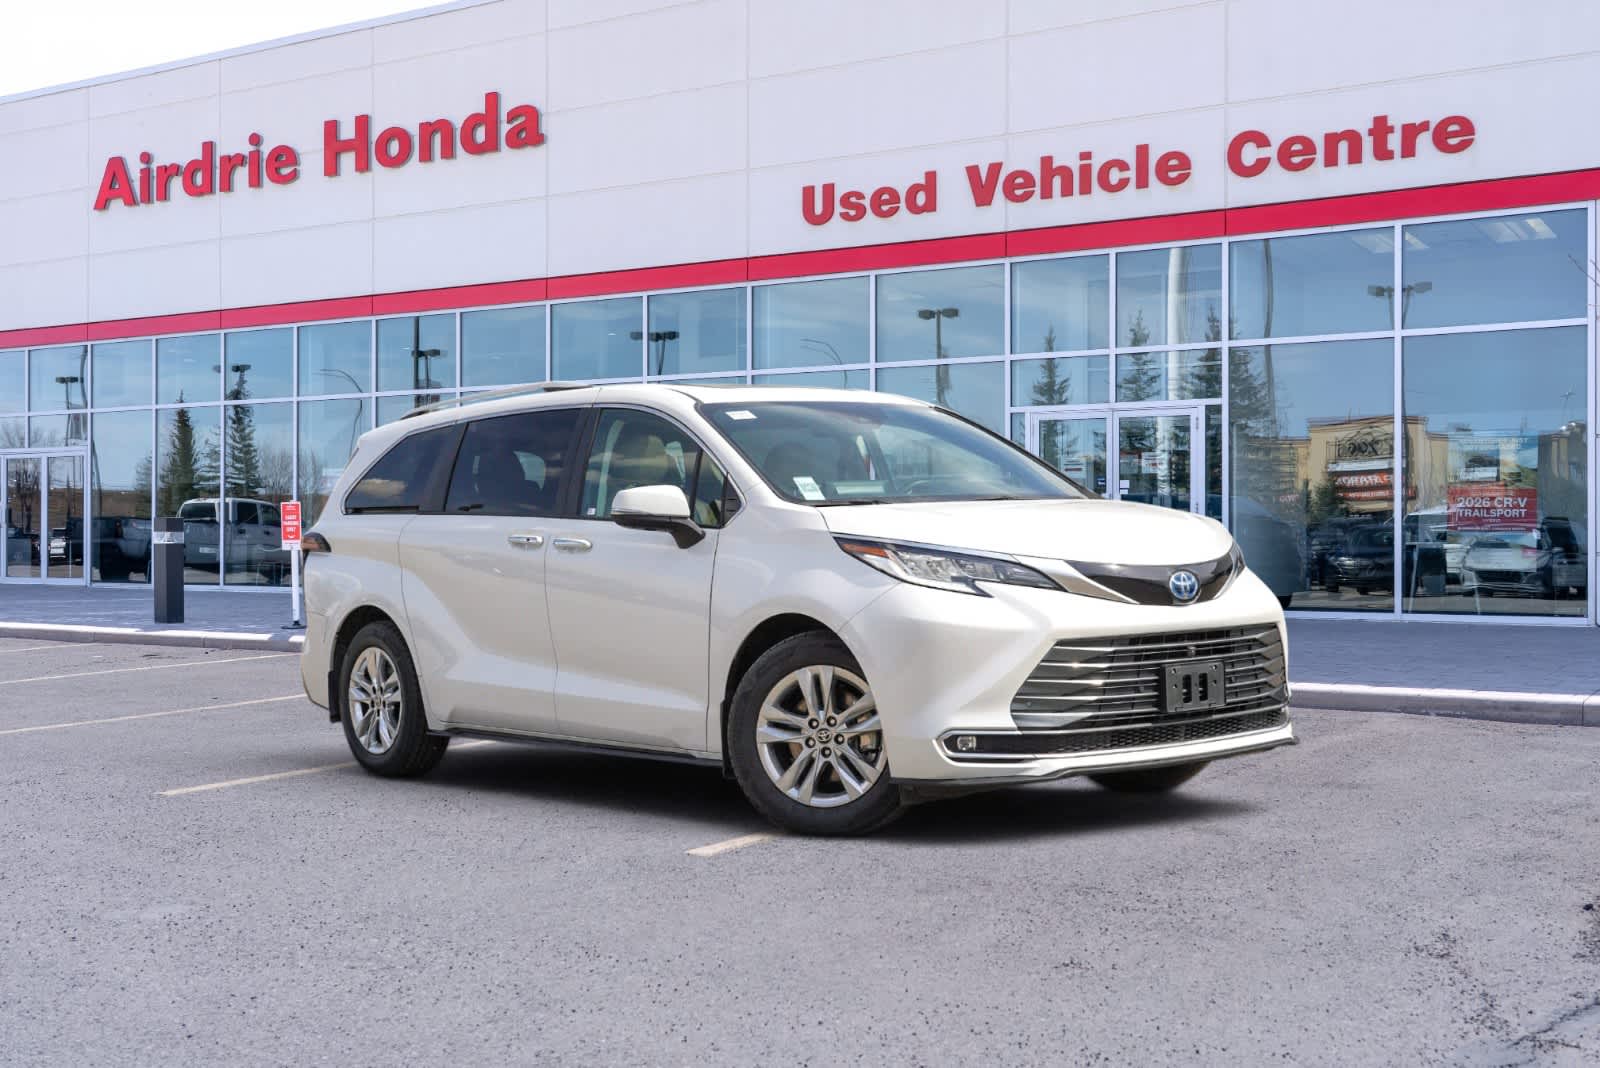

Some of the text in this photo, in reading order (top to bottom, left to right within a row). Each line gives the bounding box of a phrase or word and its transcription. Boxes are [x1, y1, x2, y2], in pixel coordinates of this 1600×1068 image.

[94, 92, 545, 210] Airdrie Honda
[802, 115, 1476, 225] Used Vehicle Centre
[1456, 497, 1528, 507] 2026 CR-V
[1458, 508, 1527, 518] TRAILSPORT
